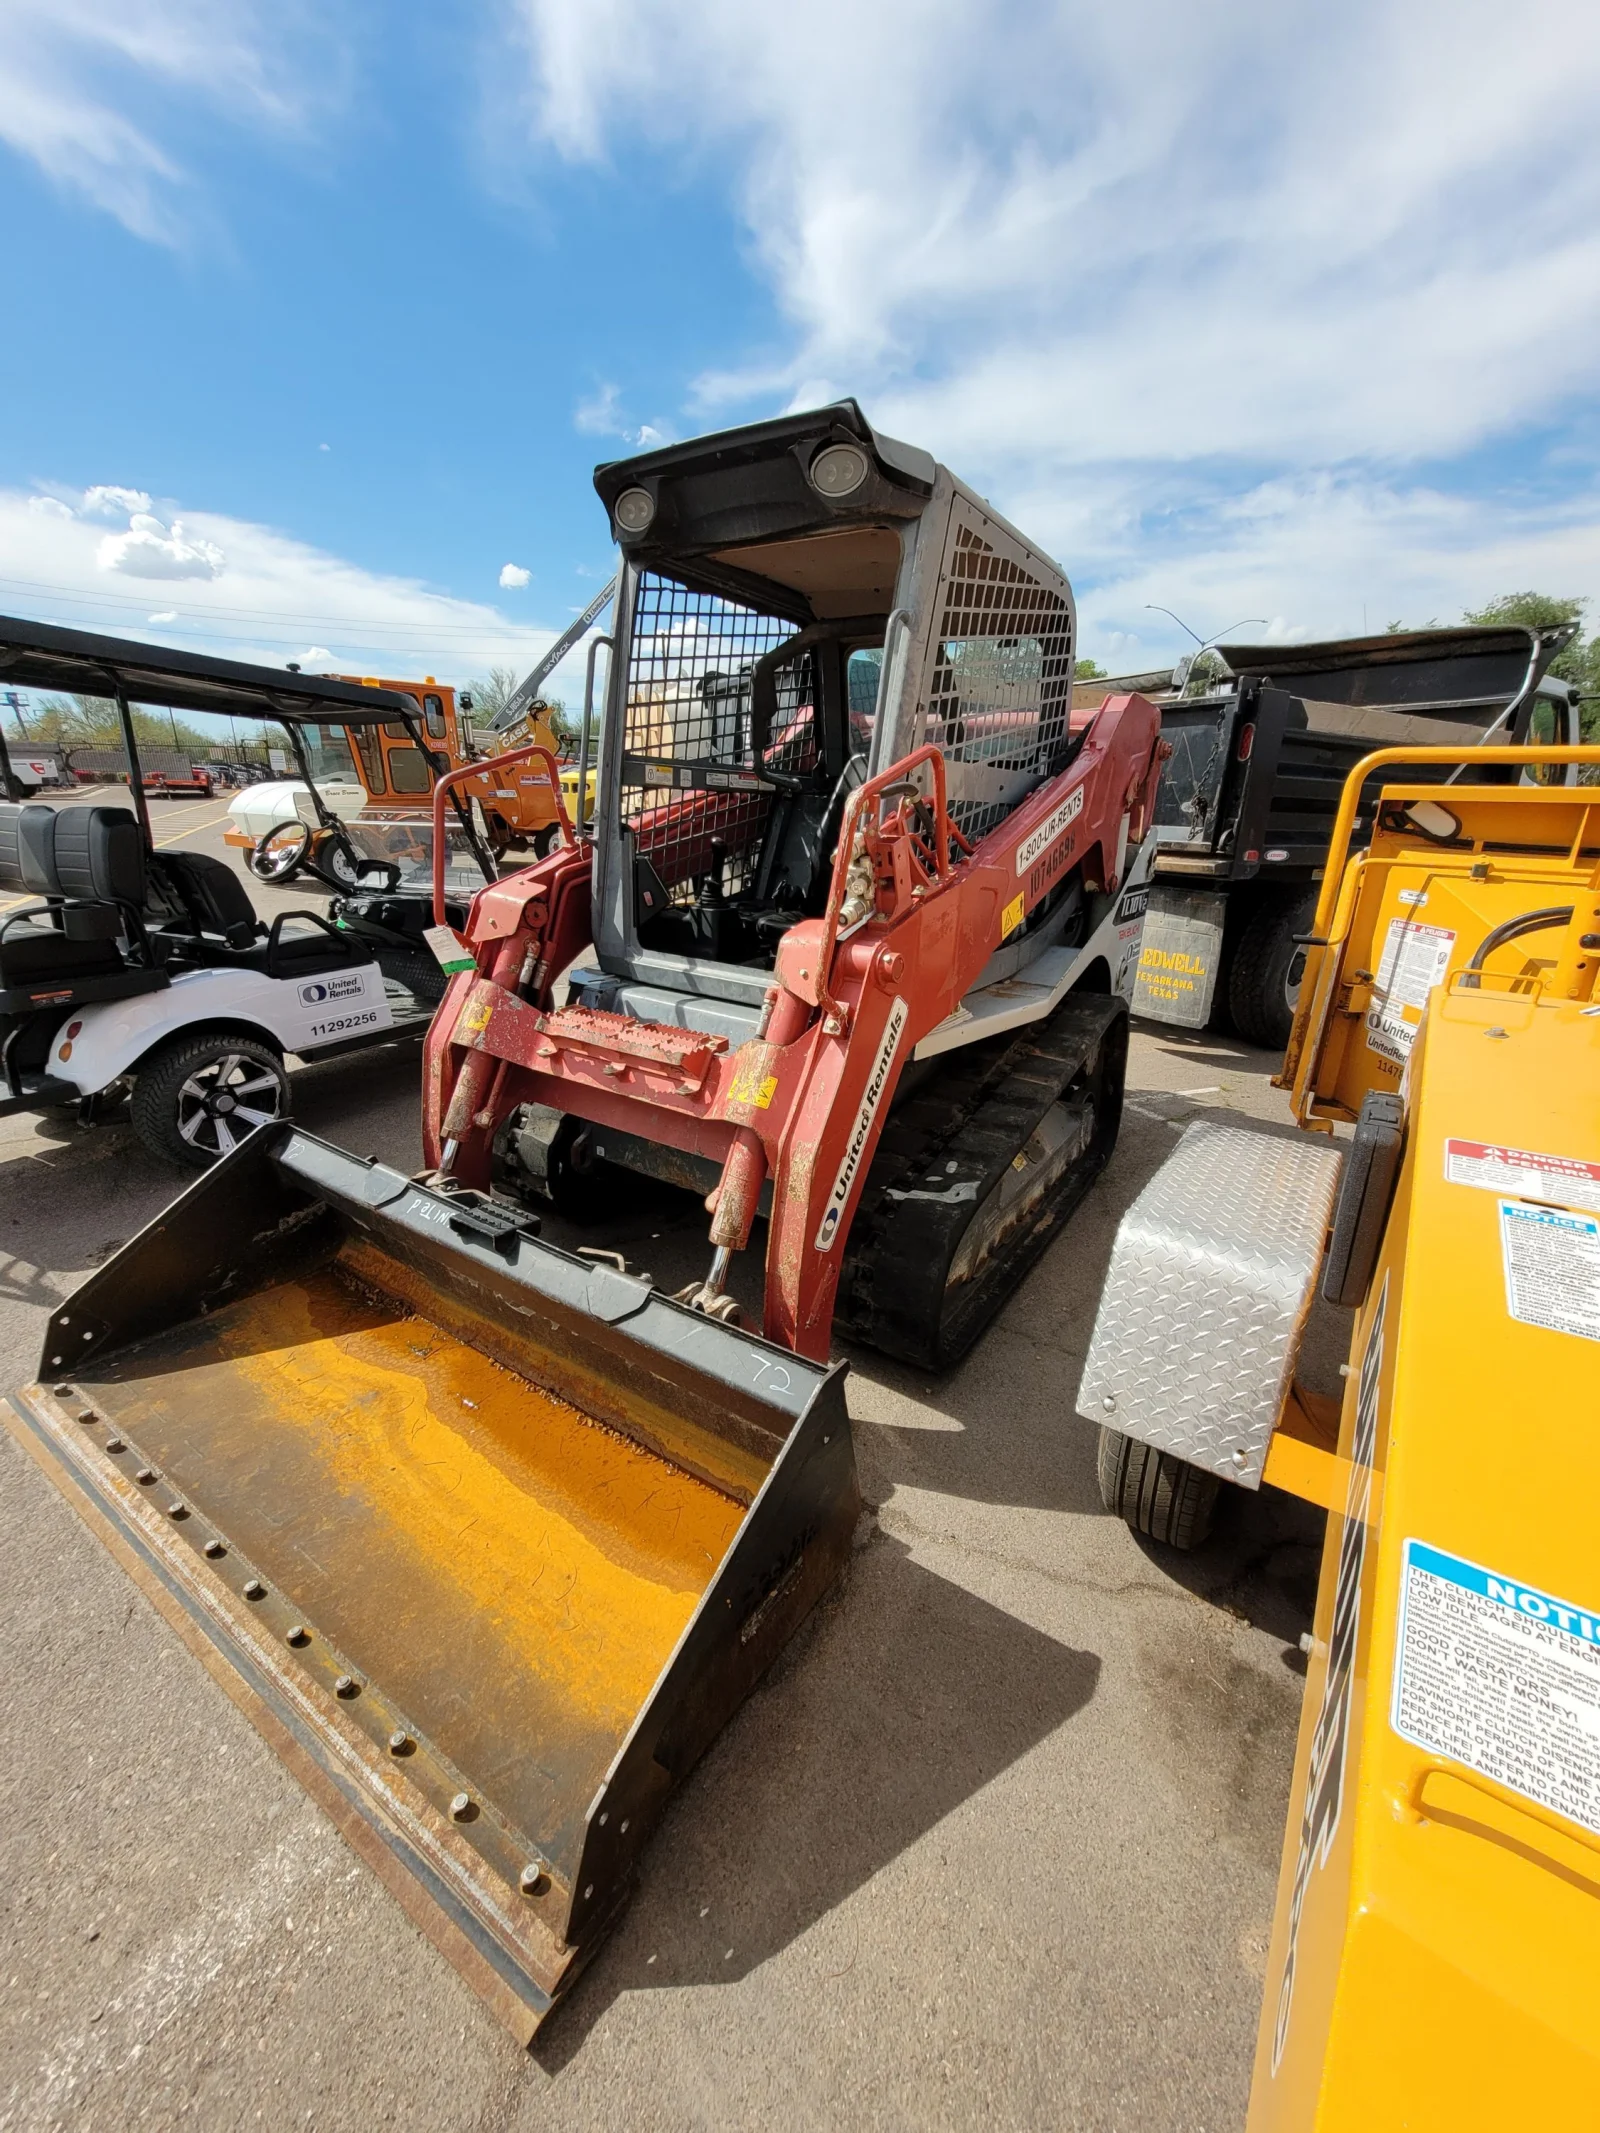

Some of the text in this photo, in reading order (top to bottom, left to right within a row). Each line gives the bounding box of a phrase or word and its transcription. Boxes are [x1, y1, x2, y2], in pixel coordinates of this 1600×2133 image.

[543, 642, 571, 674] SKYJACK
[502, 723, 529, 747] CASE
[1019, 792, 1081, 867] 1-800-UR-RENTS
[328, 977, 357, 990] United
[330, 986, 361, 999] Rentals
[1148, 986, 1179, 1000] TEXAS
[311, 1012, 377, 1036] 11292256
[835, 1008, 902, 1201] United Rentals
[1507, 1150, 1588, 1171] DANGER
[1507, 1156, 1594, 1179] PELIGRO
[1512, 1210, 1586, 1231] NOTICE
[1516, 1314, 1564, 1330] CONSULT
[751, 1353, 795, 1396] 72
[1408, 1595, 1420, 1603] DO
[1422, 1602, 1440, 1612] NOT
[1442, 1611, 1472, 1627] operate
[1474, 1624, 1489, 1635] this
[1491, 1632, 1540, 1658] Clutch/PTO
[1542, 1656, 1571, 1672] unless
[1410, 1587, 1483, 1625] LOW IDLE.
[1410, 1577, 1600, 1666] OR DISENGAGED AT ENGI
[1411, 1567, 1437, 1585] THE
[1445, 1582, 1505, 1614] CLUTCH
[1514, 1612, 1580, 1646] SHOULD
[1407, 1609, 1596, 1699] Different brands and models require different
[1407, 1625, 1550, 1697] GOOD OPERATORS
[1407, 1617, 1454, 1641] procedures.
[1458, 1640, 1476, 1652] New
[1479, 1649, 1534, 1678] Clutch/PTO's
[1537, 1677, 1568, 1695] require
[1571, 1693, 1595, 1706] more
[1407, 1635, 1449, 1660] DON'T
[1455, 1657, 1509, 1690] WASTE
[1514, 1685, 1578, 1723] MONEY!
[1408, 1602, 1598, 1691] lubrication are maintained per the Clutch/PTO
[1403, 1677, 1453, 1707] LEAVING
[1457, 1703, 1481, 1722] THE
[1485, 1719, 1537, 1750] CLUTCH
[1403, 1670, 1593, 1766] adjusted clutch should function properly
[1404, 1654, 1587, 1744] adjustment. This will cost the owner
[1404, 1661, 1449, 1686] thousands
[1462, 1690, 1493, 1708] dollars
[1495, 1705, 1504, 1713] to
[1507, 1712, 1536, 1729] repair.
[1549, 1732, 1569, 1745] well
[1405, 1645, 1442, 1666] Clutches
[1445, 1665, 1460, 1676] will
[1483, 1684, 1507, 1697] glaze
[1537, 1710, 1555, 1721] and
[1559, 1718, 1582, 1734] burn
[1585, 1732, 1598, 1741] up
[1400, 1720, 1472, 1762] OPERATING
[1475, 1760, 1502, 1778] AND
[1401, 1709, 1600, 1816] PLATE LIFE! REFER TO CLUTC
[1402, 1698, 1590, 1799] REDUCE PILOT BEARING AND
[1403, 1688, 1427, 1705] FOR
[1430, 1702, 1472, 1727] SHORT
[1476, 1724, 1533, 1759] PERIODS
[1537, 1756, 1555, 1768] OF
[1559, 1765, 1593, 1788] TIME
